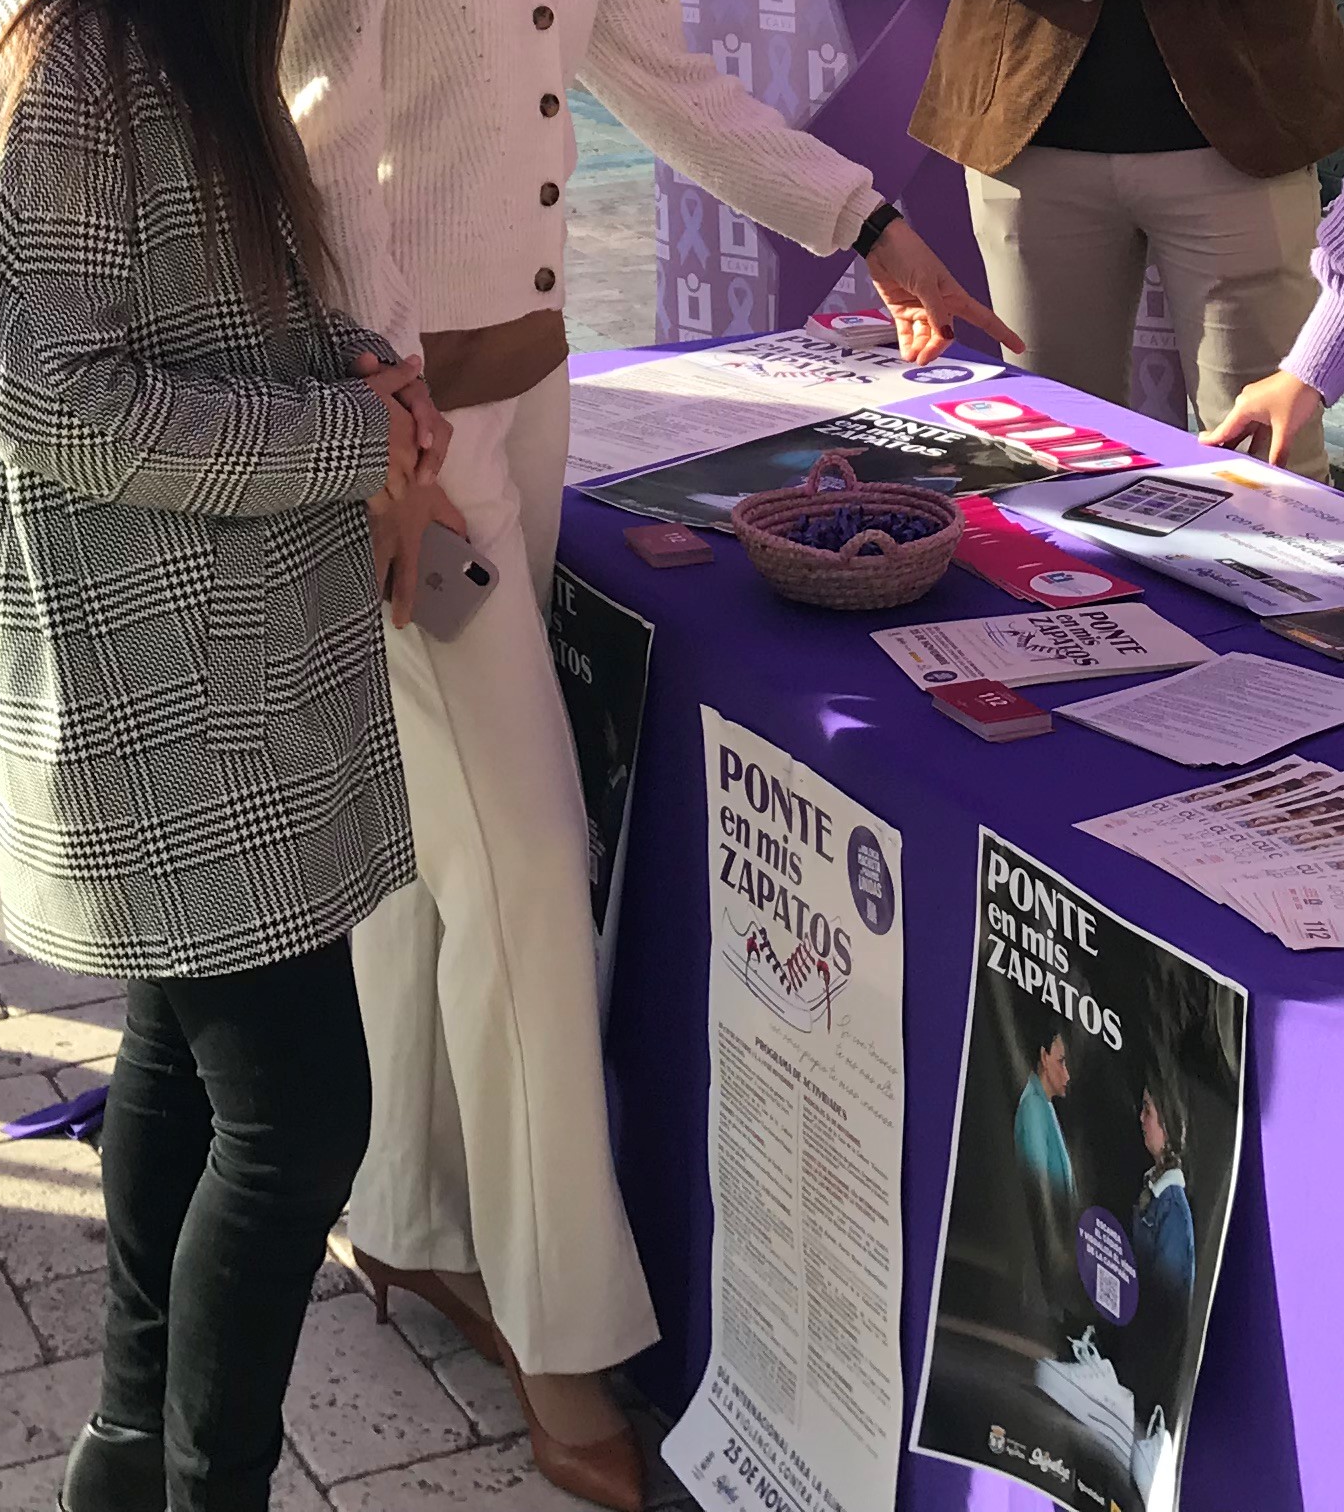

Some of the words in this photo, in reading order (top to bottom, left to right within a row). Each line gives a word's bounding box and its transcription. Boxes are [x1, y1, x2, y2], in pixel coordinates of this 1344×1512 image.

[729, 347, 879, 384] ZAPATOS
[813, 424, 947, 457] ZAPATOS
[834, 419, 867, 431] en
[871, 427, 916, 442] mis
[851, 411, 967, 442] PONTE
[1028, 616, 1100, 666] ZAPATOS
[1056, 614, 1080, 627] en
[1069, 627, 1102, 646] mis
[1079, 611, 1147, 655] PONTE
[978, 692, 1008, 707] 112
[719, 744, 834, 864] PONTE
[720, 805, 751, 849] en
[757, 834, 803, 886] mis
[719, 842, 852, 976] ZAPATOS
[987, 849, 1099, 957] PONTE
[988, 902, 1016, 942] en
[1022, 929, 1069, 974] mis
[1303, 920, 1331, 939] 112
[986, 933, 1123, 1051] ZAPATOS
[722, 1437, 740, 1465] 25
[738, 1456, 760, 1485] DE
